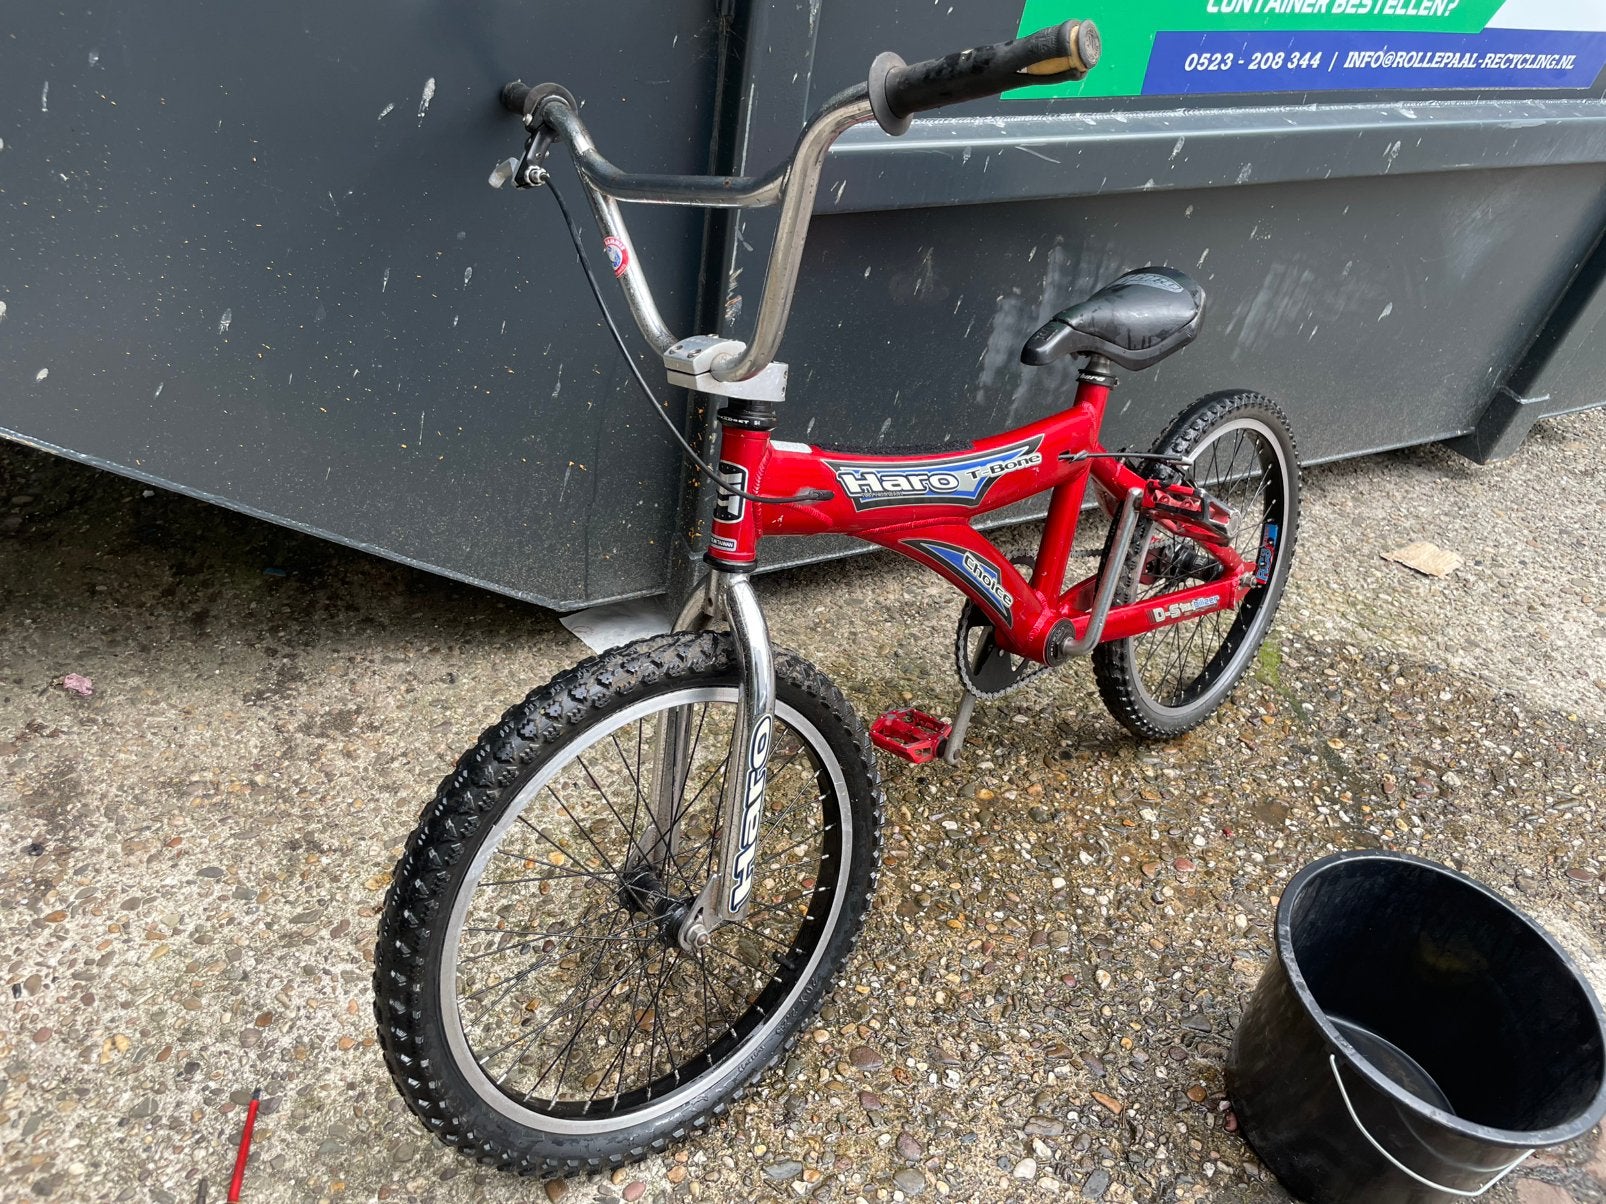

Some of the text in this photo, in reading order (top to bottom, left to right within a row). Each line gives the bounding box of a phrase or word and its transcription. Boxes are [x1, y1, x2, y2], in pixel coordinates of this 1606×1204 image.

[1184, 52, 1234, 72] 0523
[1248, 51, 1285, 70] 208
[1287, 51, 1322, 69] 344
[1343, 51, 1576, 70] INFO@ROLLEPAAL-RECYCLING.NL
[837, 453, 1042, 495] Haro T-Bone
[963, 553, 1013, 607] Choice
[730, 714, 772, 912] Haro
